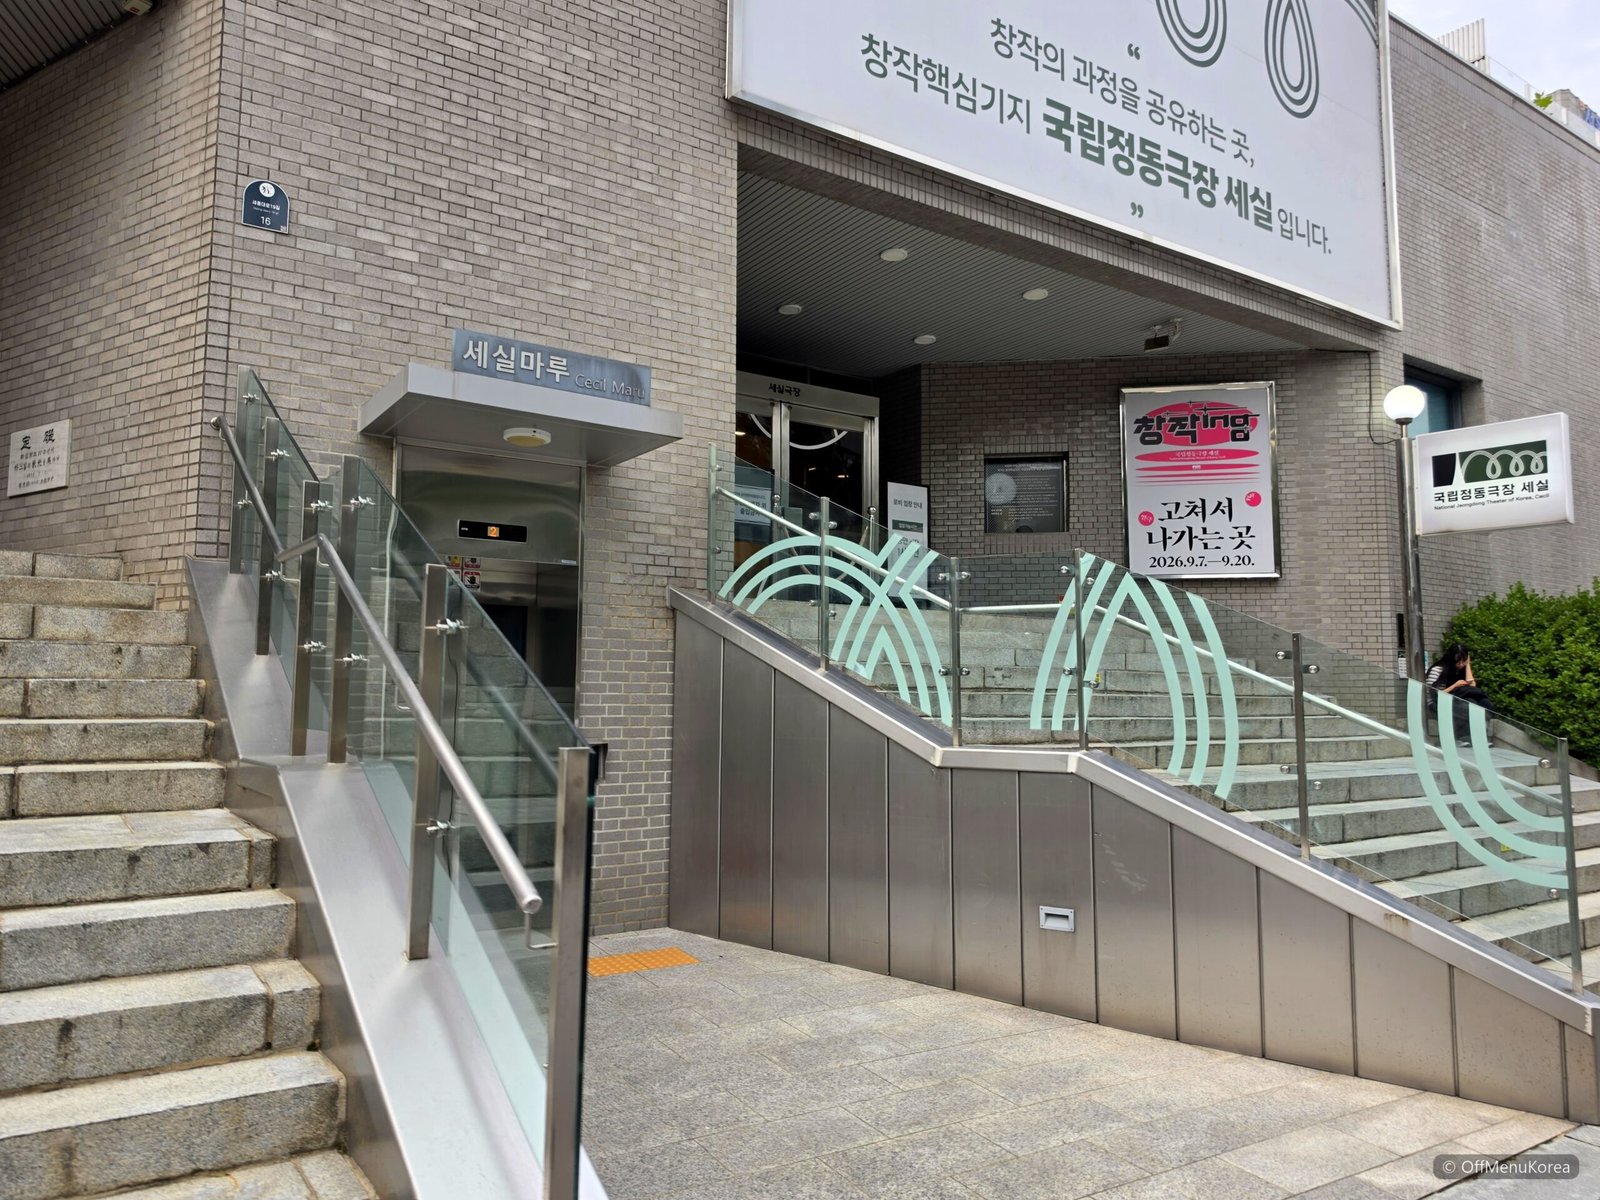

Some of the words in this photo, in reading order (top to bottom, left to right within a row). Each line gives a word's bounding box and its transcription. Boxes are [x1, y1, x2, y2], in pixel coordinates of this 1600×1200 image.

[990, 17, 1065, 81] 창작의
[1072, 55, 1140, 115] 과정을
[1146, 89, 1226, 153] 공유하는
[1231, 128, 1254, 168] 곳,
[861, 33, 1031, 134] 창작핵심기지
[1043, 97, 1219, 209] 국립정동극장
[1224, 176, 1273, 232] 세실
[1277, 208, 1332, 255] 입니다.
[261, 216, 271, 226] 16
[463, 340, 570, 383] 세실마루
[575, 374, 607, 391] Cecil
[612, 380, 645, 400] Maru
[769, 383, 800, 398] 세실극장
[1434, 483, 1515, 504] 국립정동극장
[1521, 479, 1549, 493] 세실
[1158, 496, 1233, 523] 고쳐서
[1434, 502, 1455, 511] National
[1146, 525, 1225, 551] 나가는
[1229, 525, 1255, 550] 곳
